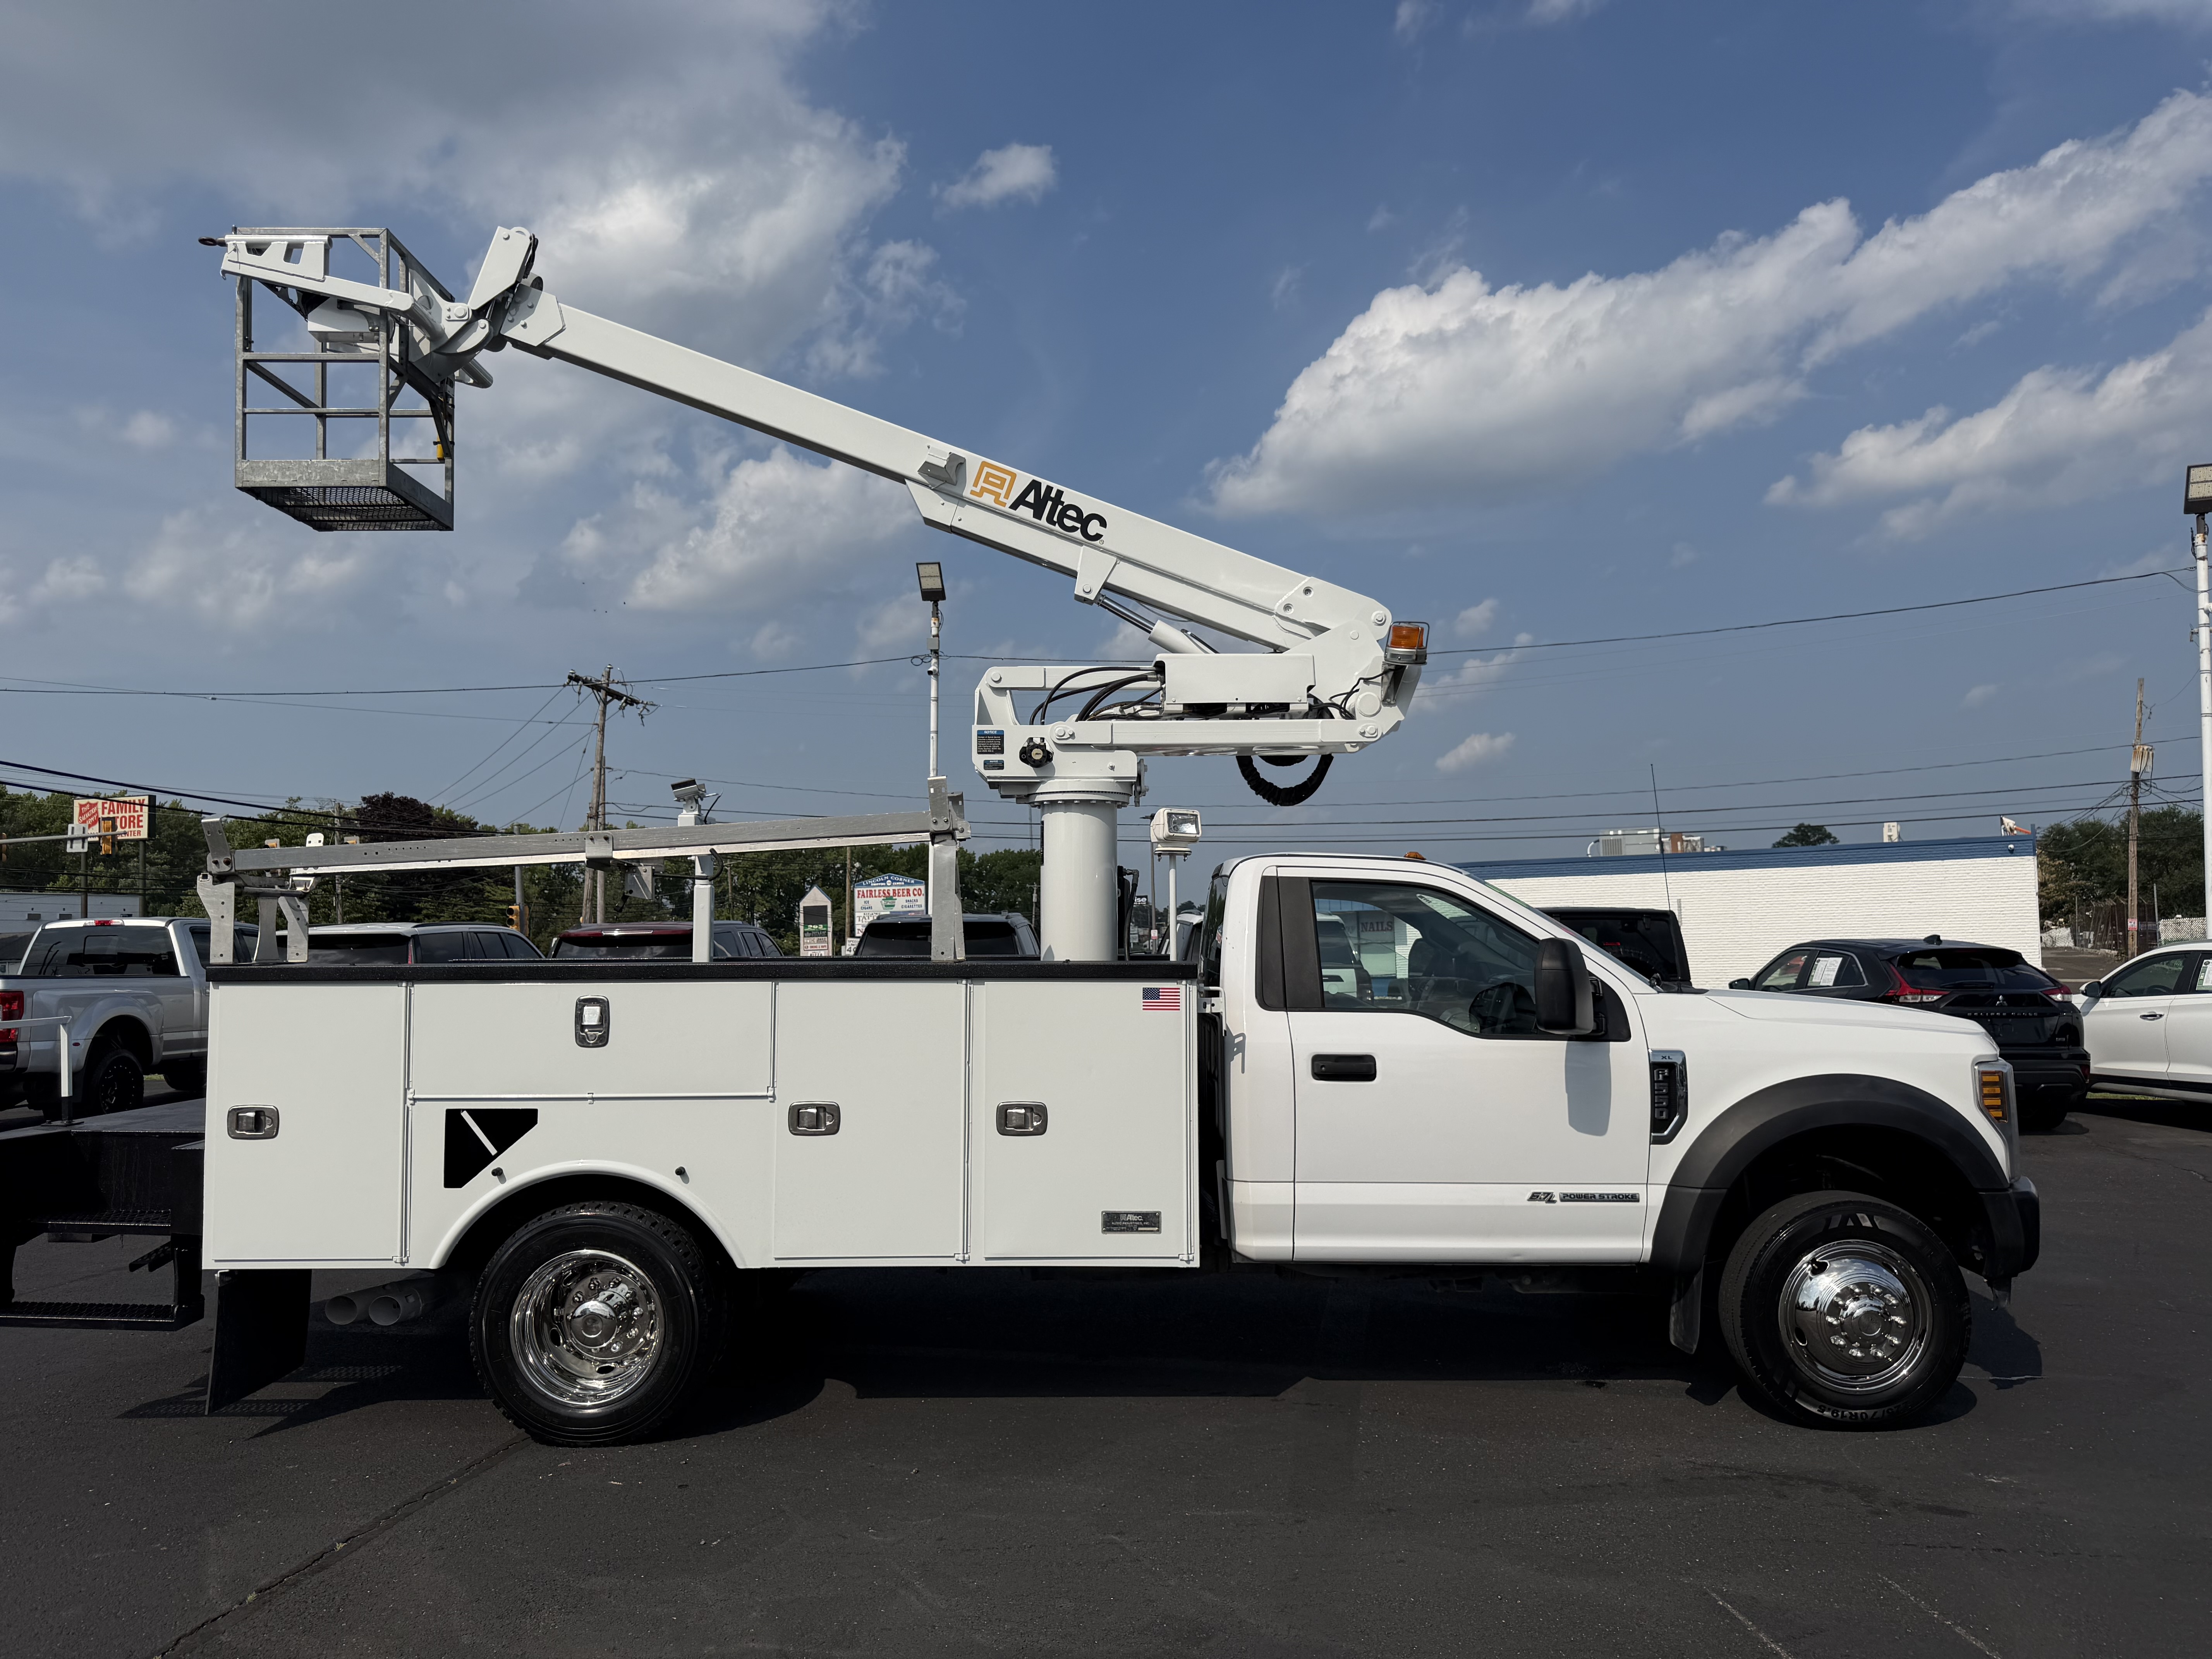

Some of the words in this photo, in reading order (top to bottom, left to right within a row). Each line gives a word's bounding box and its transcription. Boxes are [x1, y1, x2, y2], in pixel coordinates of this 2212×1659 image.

[1009, 479, 1107, 542] Altec
[79, 805, 98, 823] SALVATION
[81, 804, 90, 813] THE
[101, 799, 145, 815] FAMILY
[115, 814, 143, 830] TORE
[863, 876, 889, 886] LINCOLN
[857, 889, 891, 898] FAIRLESS
[892, 888, 911, 897] BEER
[912, 888, 924, 896] CO.
[1360, 921, 1393, 932] NAILS
[1654, 1068, 1669, 1119] F550
